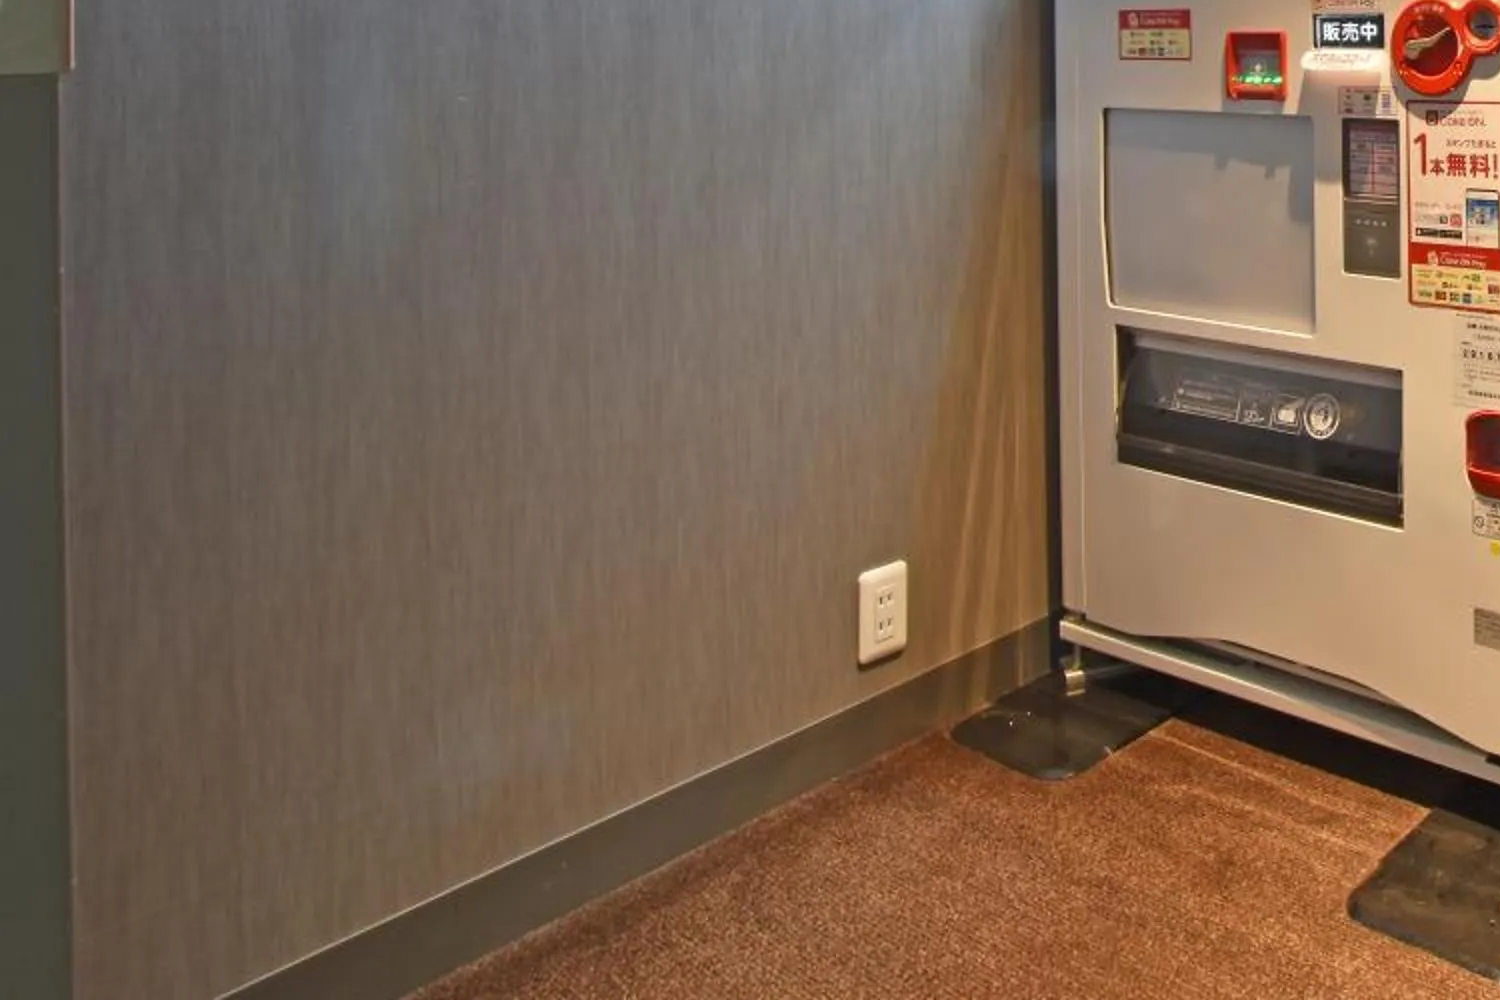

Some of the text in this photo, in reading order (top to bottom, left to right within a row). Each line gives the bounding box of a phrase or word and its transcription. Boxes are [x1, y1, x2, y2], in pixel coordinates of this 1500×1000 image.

[1323, 21, 1377, 42] 販売中
[1413, 132, 1499, 180] 1本無料!
